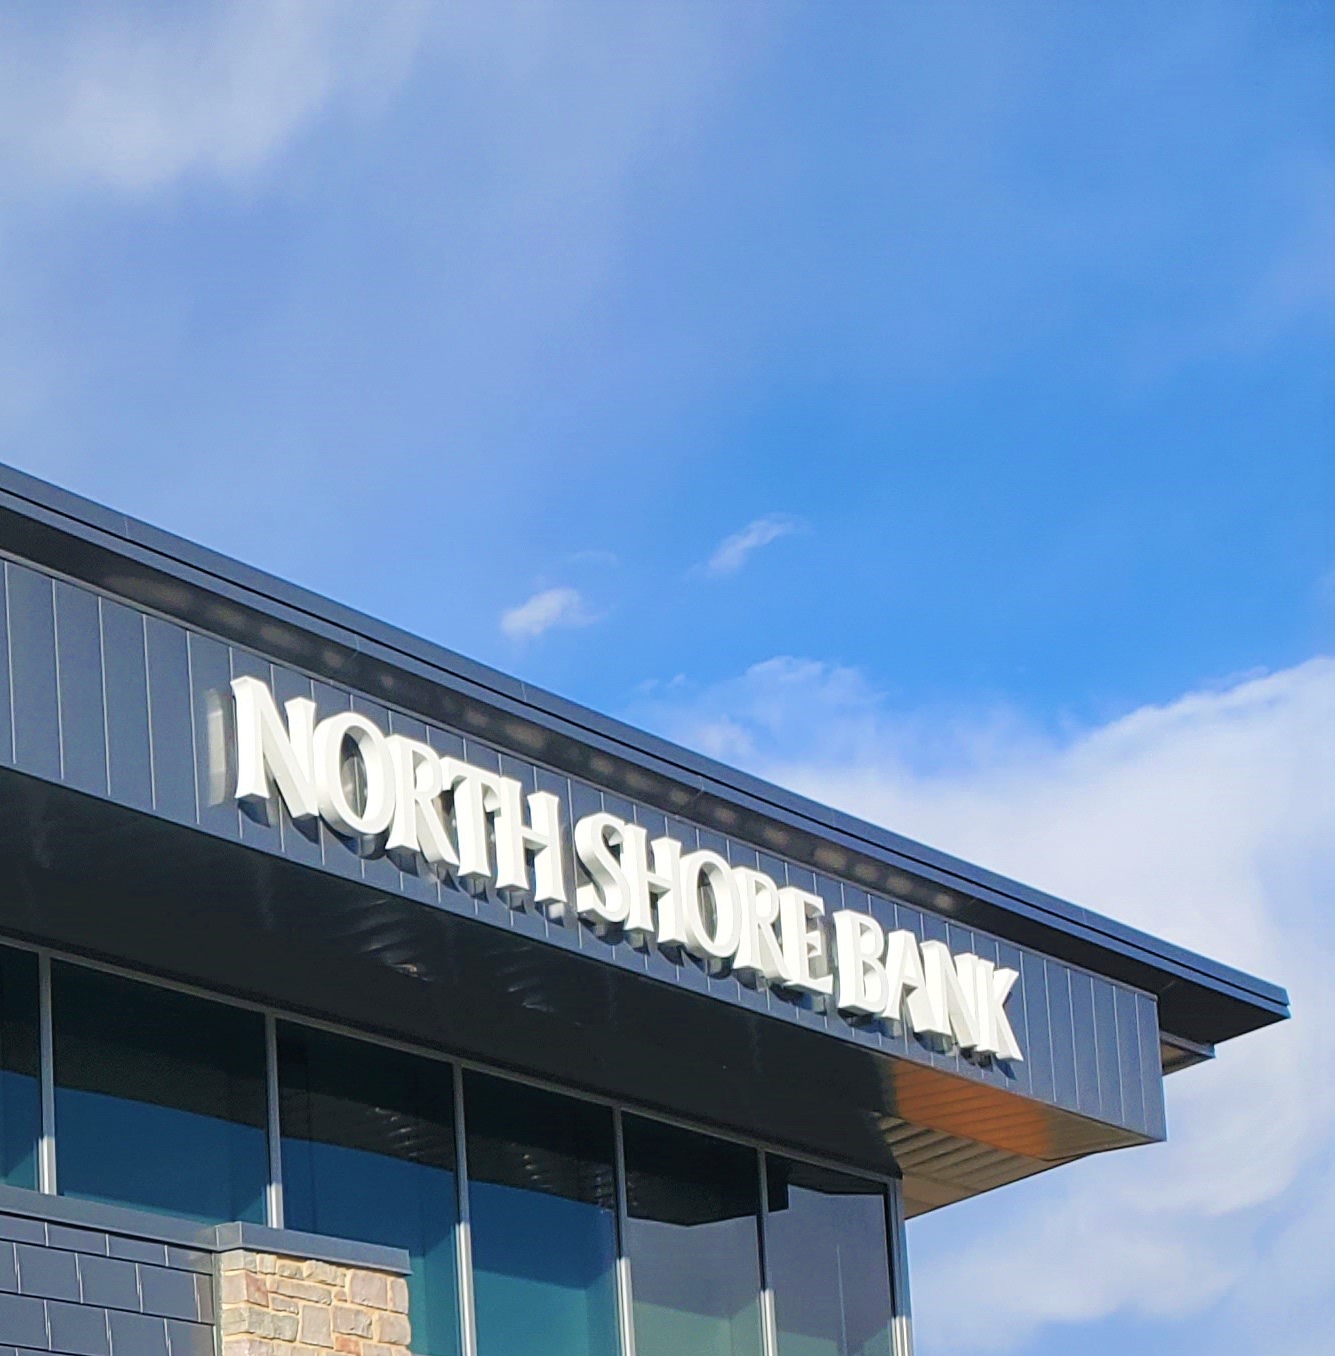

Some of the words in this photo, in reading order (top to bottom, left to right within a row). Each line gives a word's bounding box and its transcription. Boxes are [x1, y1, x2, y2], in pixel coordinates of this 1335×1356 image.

[230, 674, 567, 903] NORTH
[574, 811, 833, 995] SHORE
[832, 909, 1024, 1062] BANK
